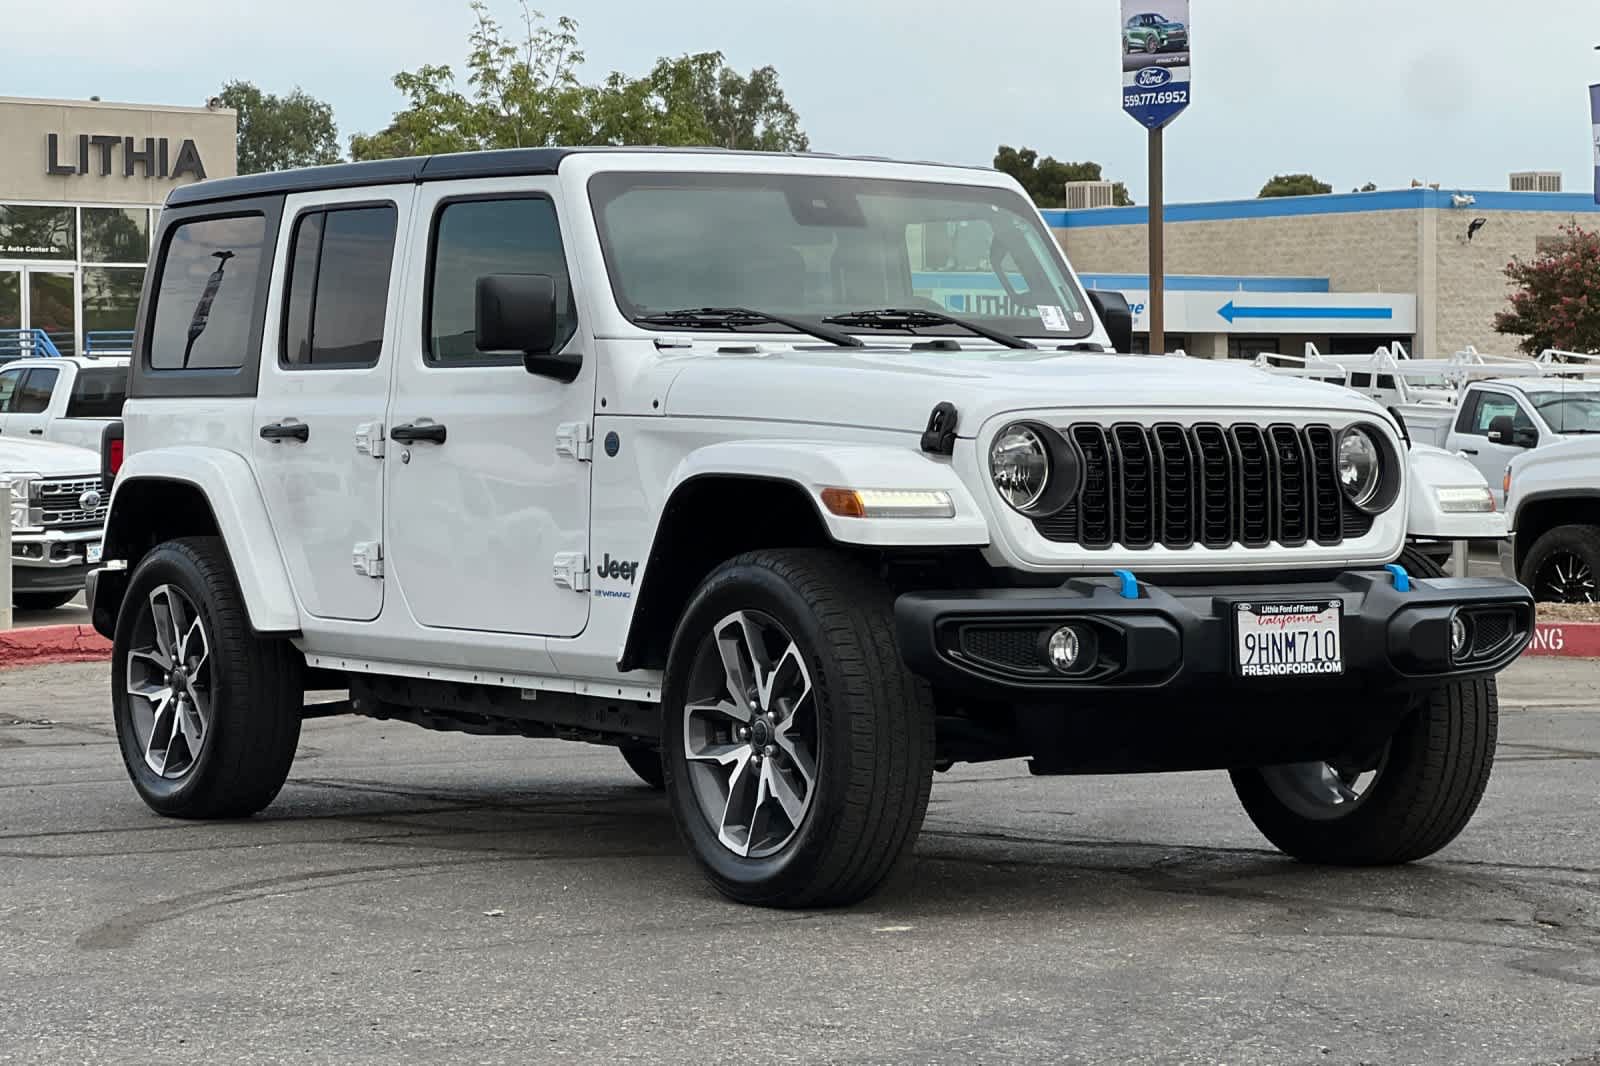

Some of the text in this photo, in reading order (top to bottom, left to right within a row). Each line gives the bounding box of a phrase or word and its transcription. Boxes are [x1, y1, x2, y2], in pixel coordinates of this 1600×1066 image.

[1139, 69, 1163, 85] Ford
[1124, 91, 1186, 107] 559.777.6952
[46, 132, 207, 179] LITHIA
[25, 245, 49, 253] Center
[1261, 606, 1279, 614] Lithia
[1279, 605, 1293, 613] Ford
[1300, 604, 1318, 612] Fresno
[1245, 630, 1336, 664] 9HNM710
[1242, 662, 1341, 675] FRESNOFORD.COM
